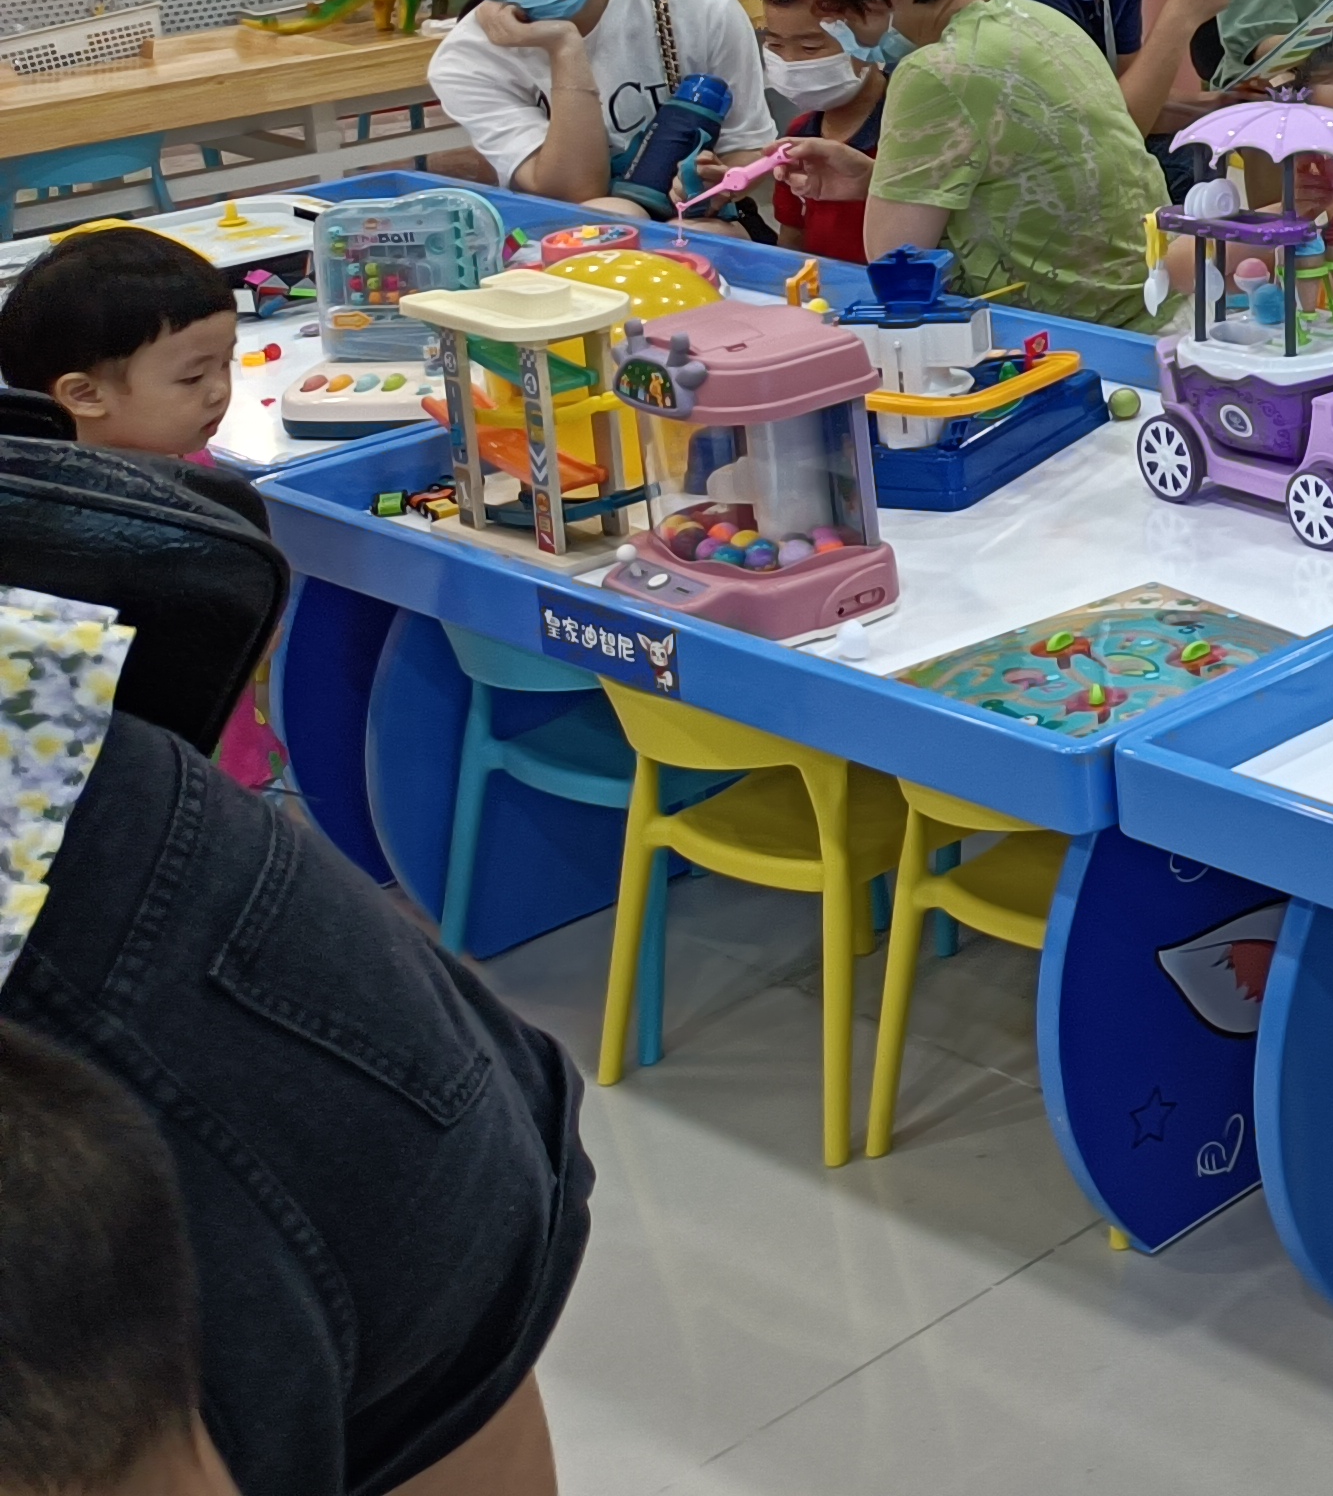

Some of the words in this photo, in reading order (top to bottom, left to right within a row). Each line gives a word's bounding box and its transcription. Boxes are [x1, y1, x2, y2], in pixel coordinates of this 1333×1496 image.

[544, 608, 635, 662] 皇家迪智尼
